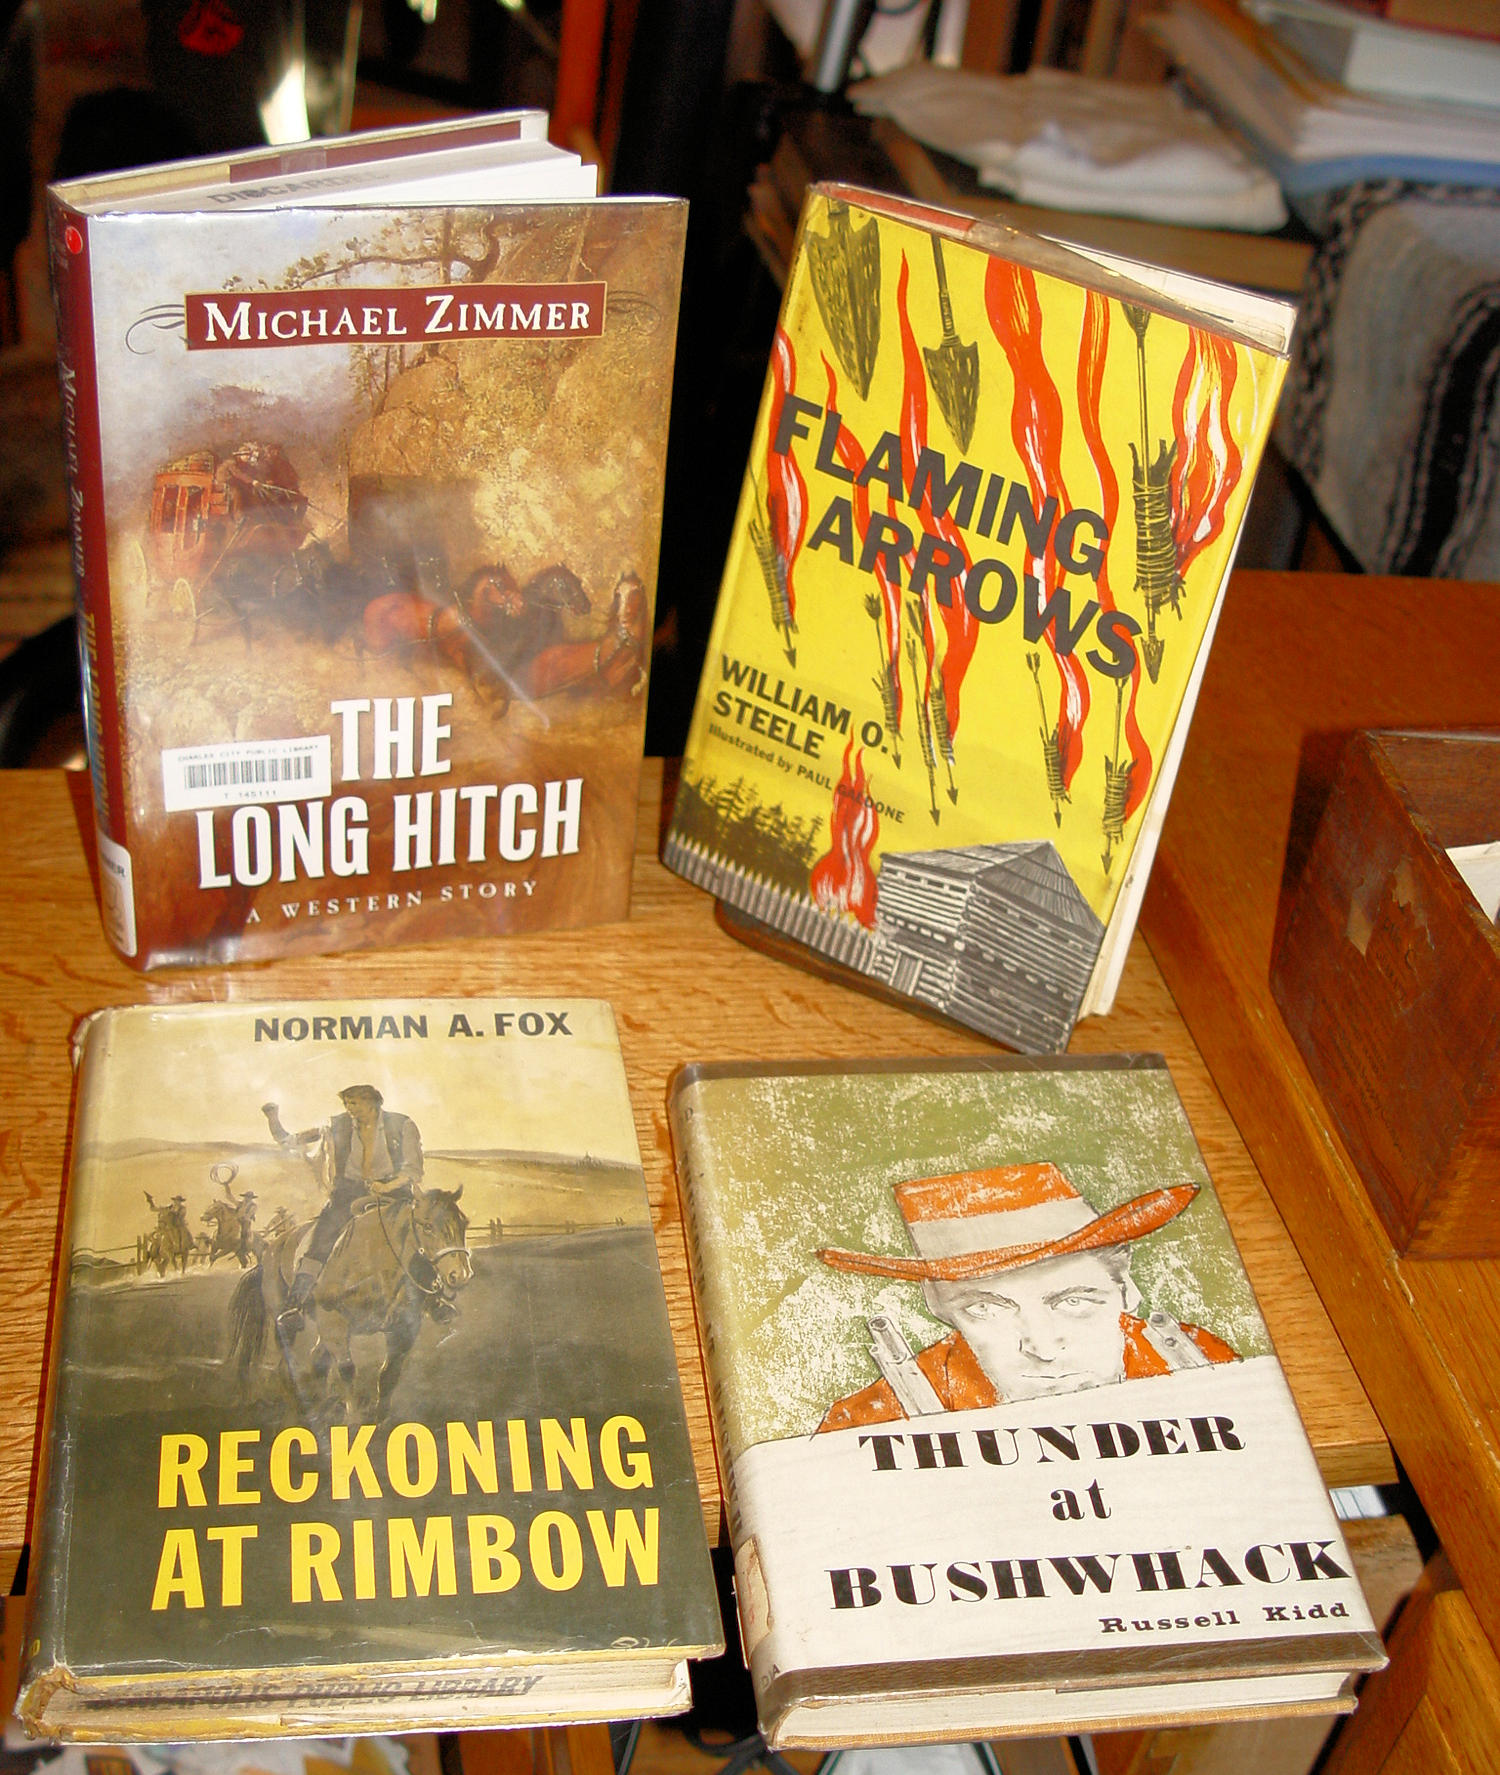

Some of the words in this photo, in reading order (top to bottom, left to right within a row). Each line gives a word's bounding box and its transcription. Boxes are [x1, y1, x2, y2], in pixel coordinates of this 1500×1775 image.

[203, 300, 407, 342] MICHAEL
[423, 294, 591, 334] ZIMMER
[772, 393, 1110, 583] FLAMING
[806, 496, 1143, 679] ARROWS
[331, 693, 453, 783] THE
[712, 690, 825, 760] STEELE
[721, 653, 852, 735] WILLIAM
[861, 720, 889, 754] O.
[220, 750, 241, 758] CITY
[246, 747, 278, 755] PUBLIC
[283, 744, 319, 753] LIBRARY
[709, 723, 774, 762] Illustrated
[777, 755, 794, 774] by
[797, 765, 832, 791] PAUL
[196, 797, 370, 889] LONG
[393, 778, 584, 872] HITCH
[247, 908, 261, 924] A
[282, 890, 422, 918] WESTERN
[441, 880, 538, 902] STORY
[254, 1015, 428, 1042] NORMAN
[447, 1014, 484, 1039] A.
[494, 1012, 573, 1037] FOX
[157, 1415, 655, 1508] RECKONING
[858, 1415, 1246, 1472] THUNDER
[1050, 1478, 1112, 1521] at
[150, 1524, 259, 1611] AT
[290, 1507, 661, 1603] RIMBOW
[824, 1538, 1353, 1610] BUSHWHACK
[1099, 1610, 1241, 1634] Russell
[1262, 1602, 1349, 1622] Kidd
[408, 1675, 544, 1702] LIBRARY
